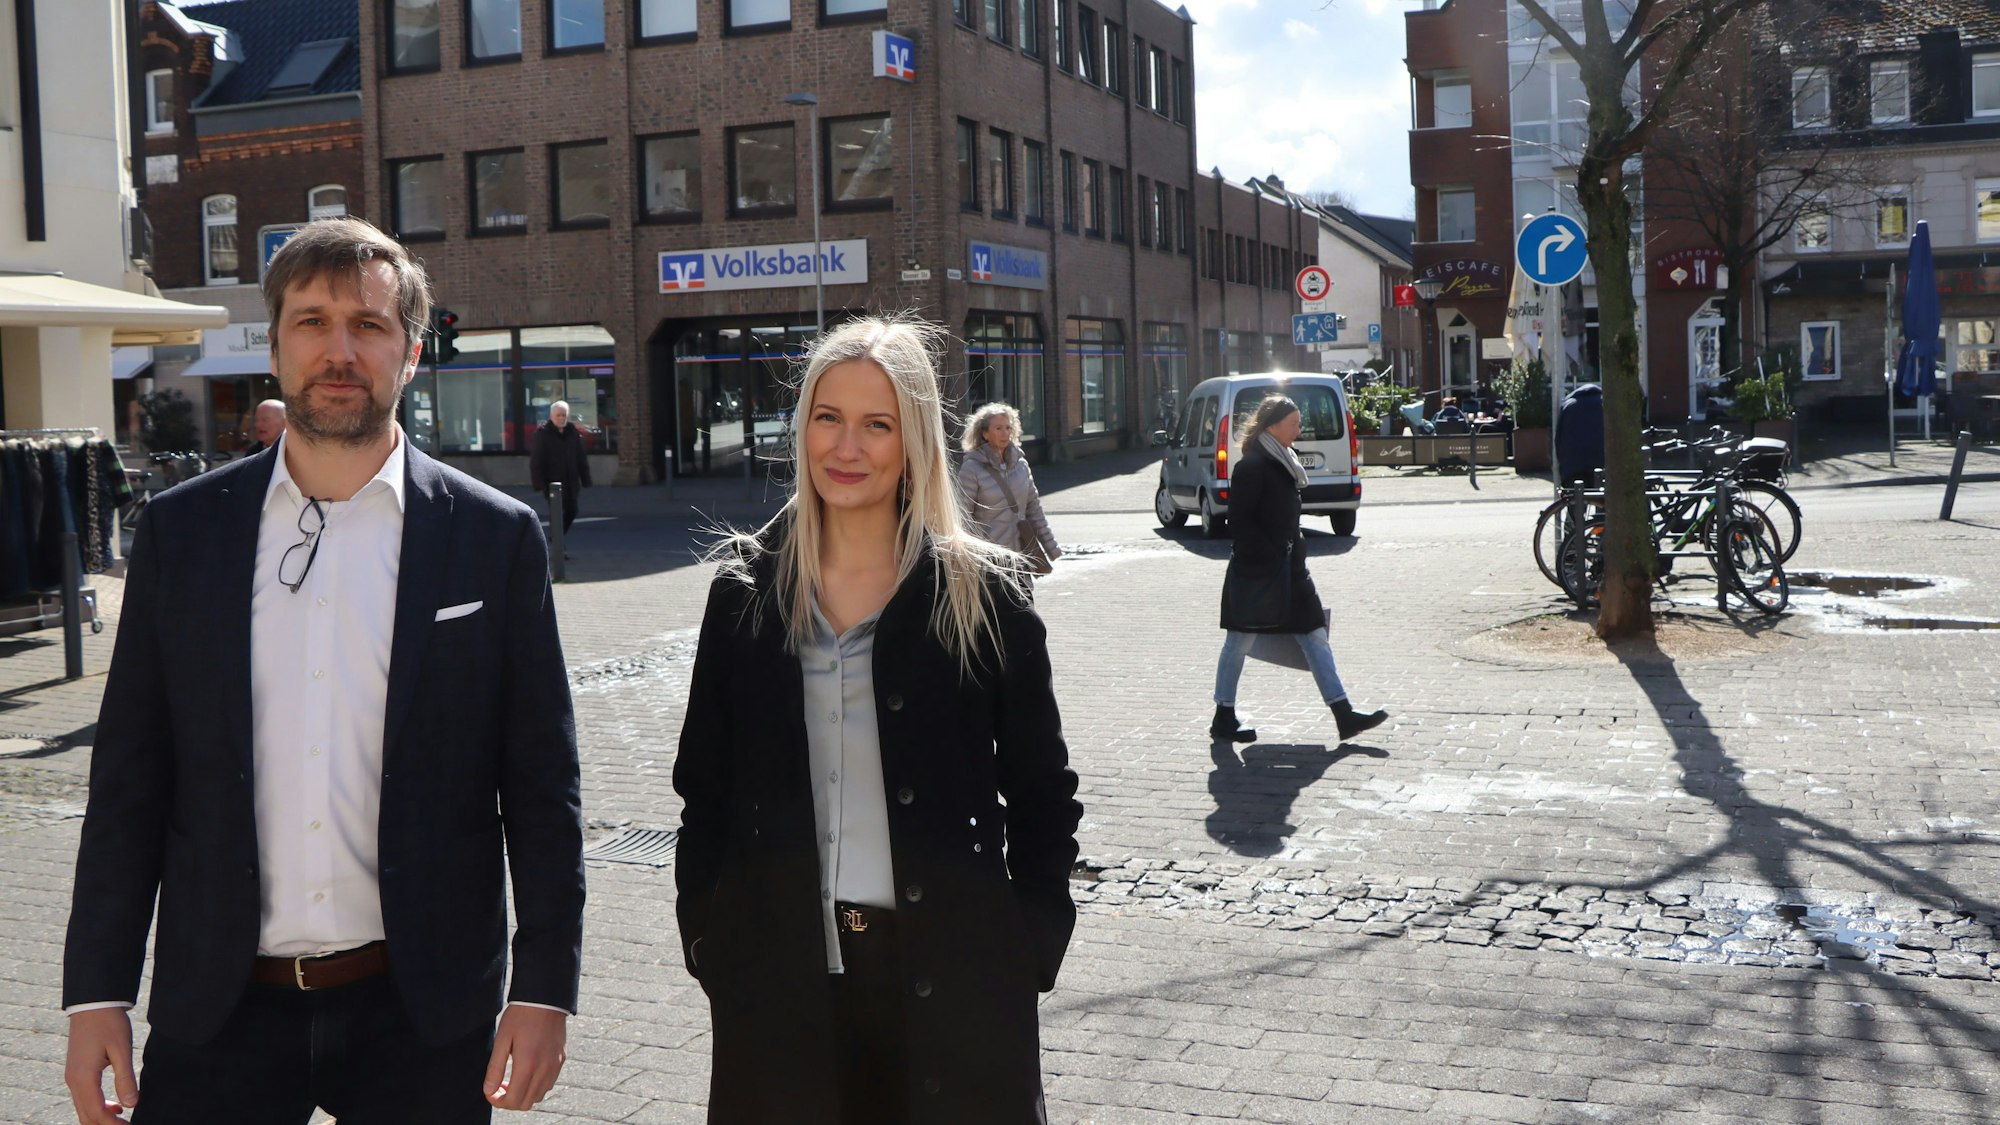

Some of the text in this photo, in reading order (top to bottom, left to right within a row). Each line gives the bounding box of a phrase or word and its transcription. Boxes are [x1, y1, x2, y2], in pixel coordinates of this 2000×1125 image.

[711, 245, 846, 279] Volksbank
[993, 250, 1042, 278] Volksbank
[1426, 261, 1501, 278] EISCAFE
[1370, 326, 1378, 337] P
[1300, 457, 1314, 466] 939
